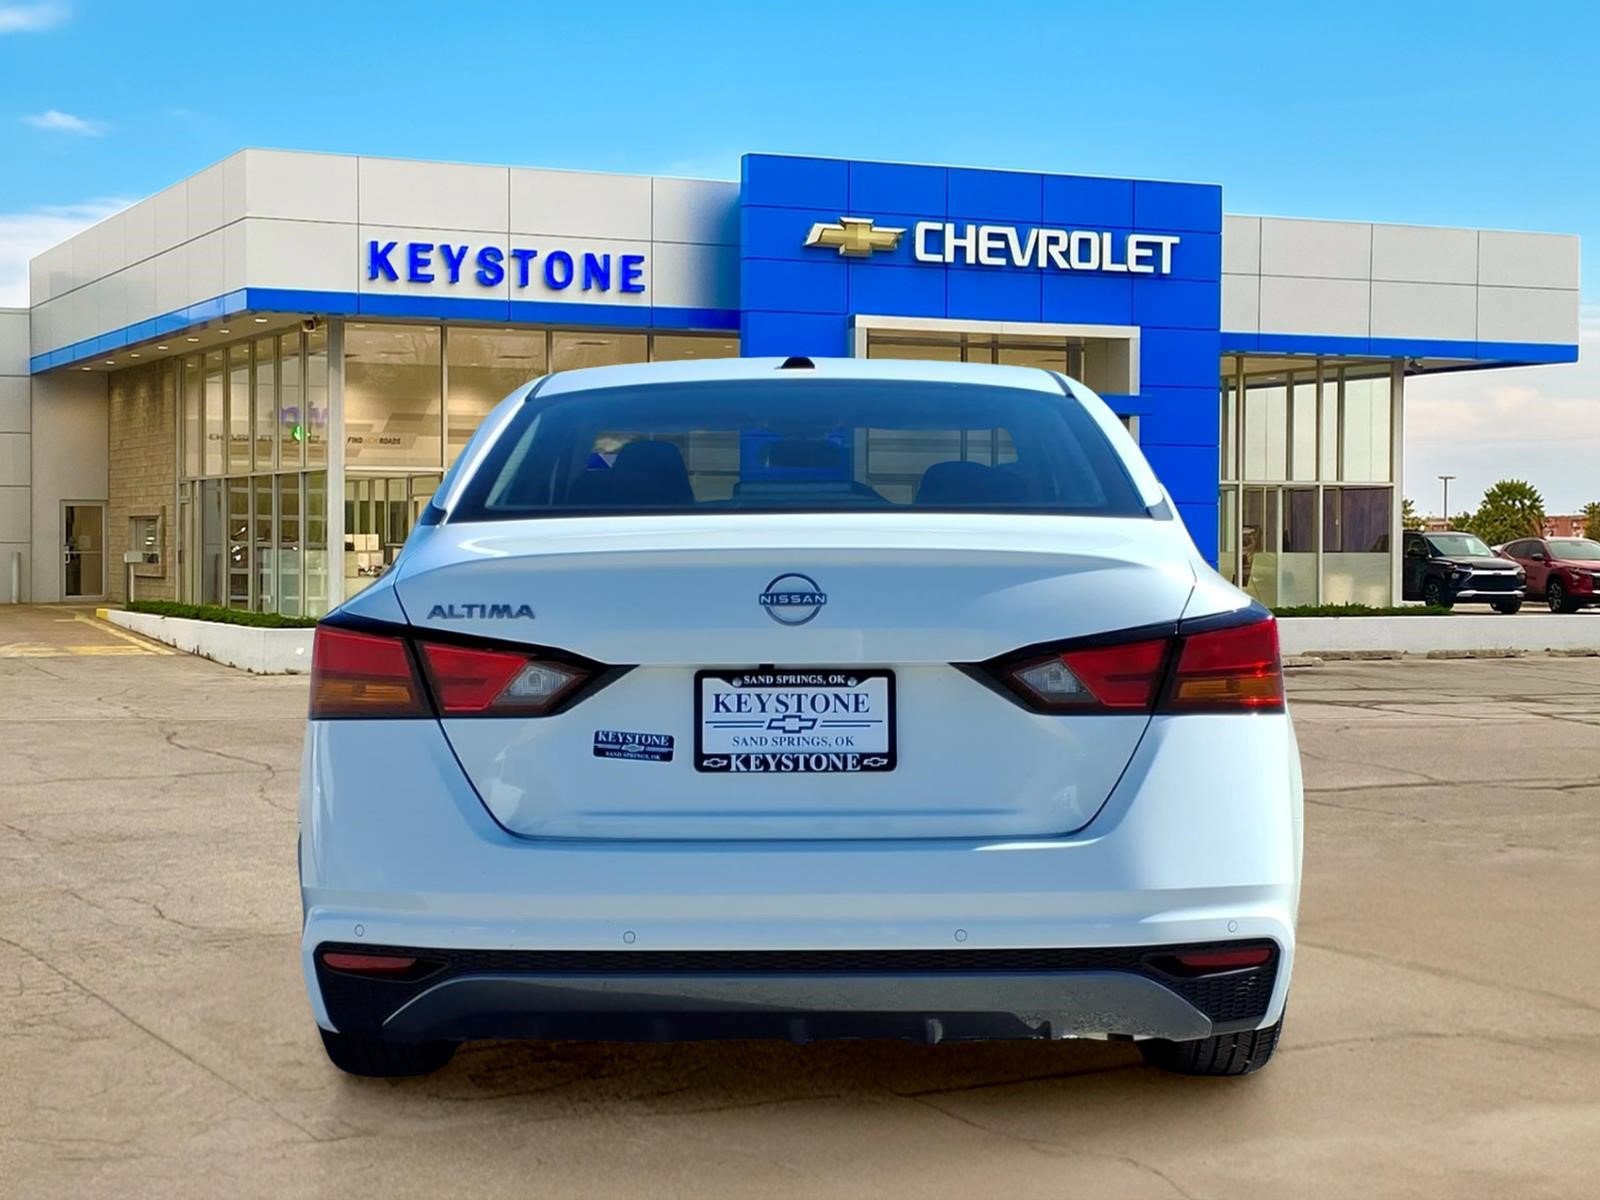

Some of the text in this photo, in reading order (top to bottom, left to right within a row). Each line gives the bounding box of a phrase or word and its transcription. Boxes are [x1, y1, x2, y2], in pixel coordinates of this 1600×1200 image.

[914, 221, 1181, 274] CHEVROLET
[368, 240, 646, 293] KEYSTONE
[760, 594, 826, 604] NISSAN
[427, 604, 535, 619] ALTIMA
[744, 675, 846, 686] SAND SPRINGS, OK
[713, 693, 870, 714] KEYSTONE
[598, 731, 669, 746] KEYSTONE
[732, 736, 855, 748] SAND SPRINGS, OK
[730, 754, 861, 772] KEYSTONE
